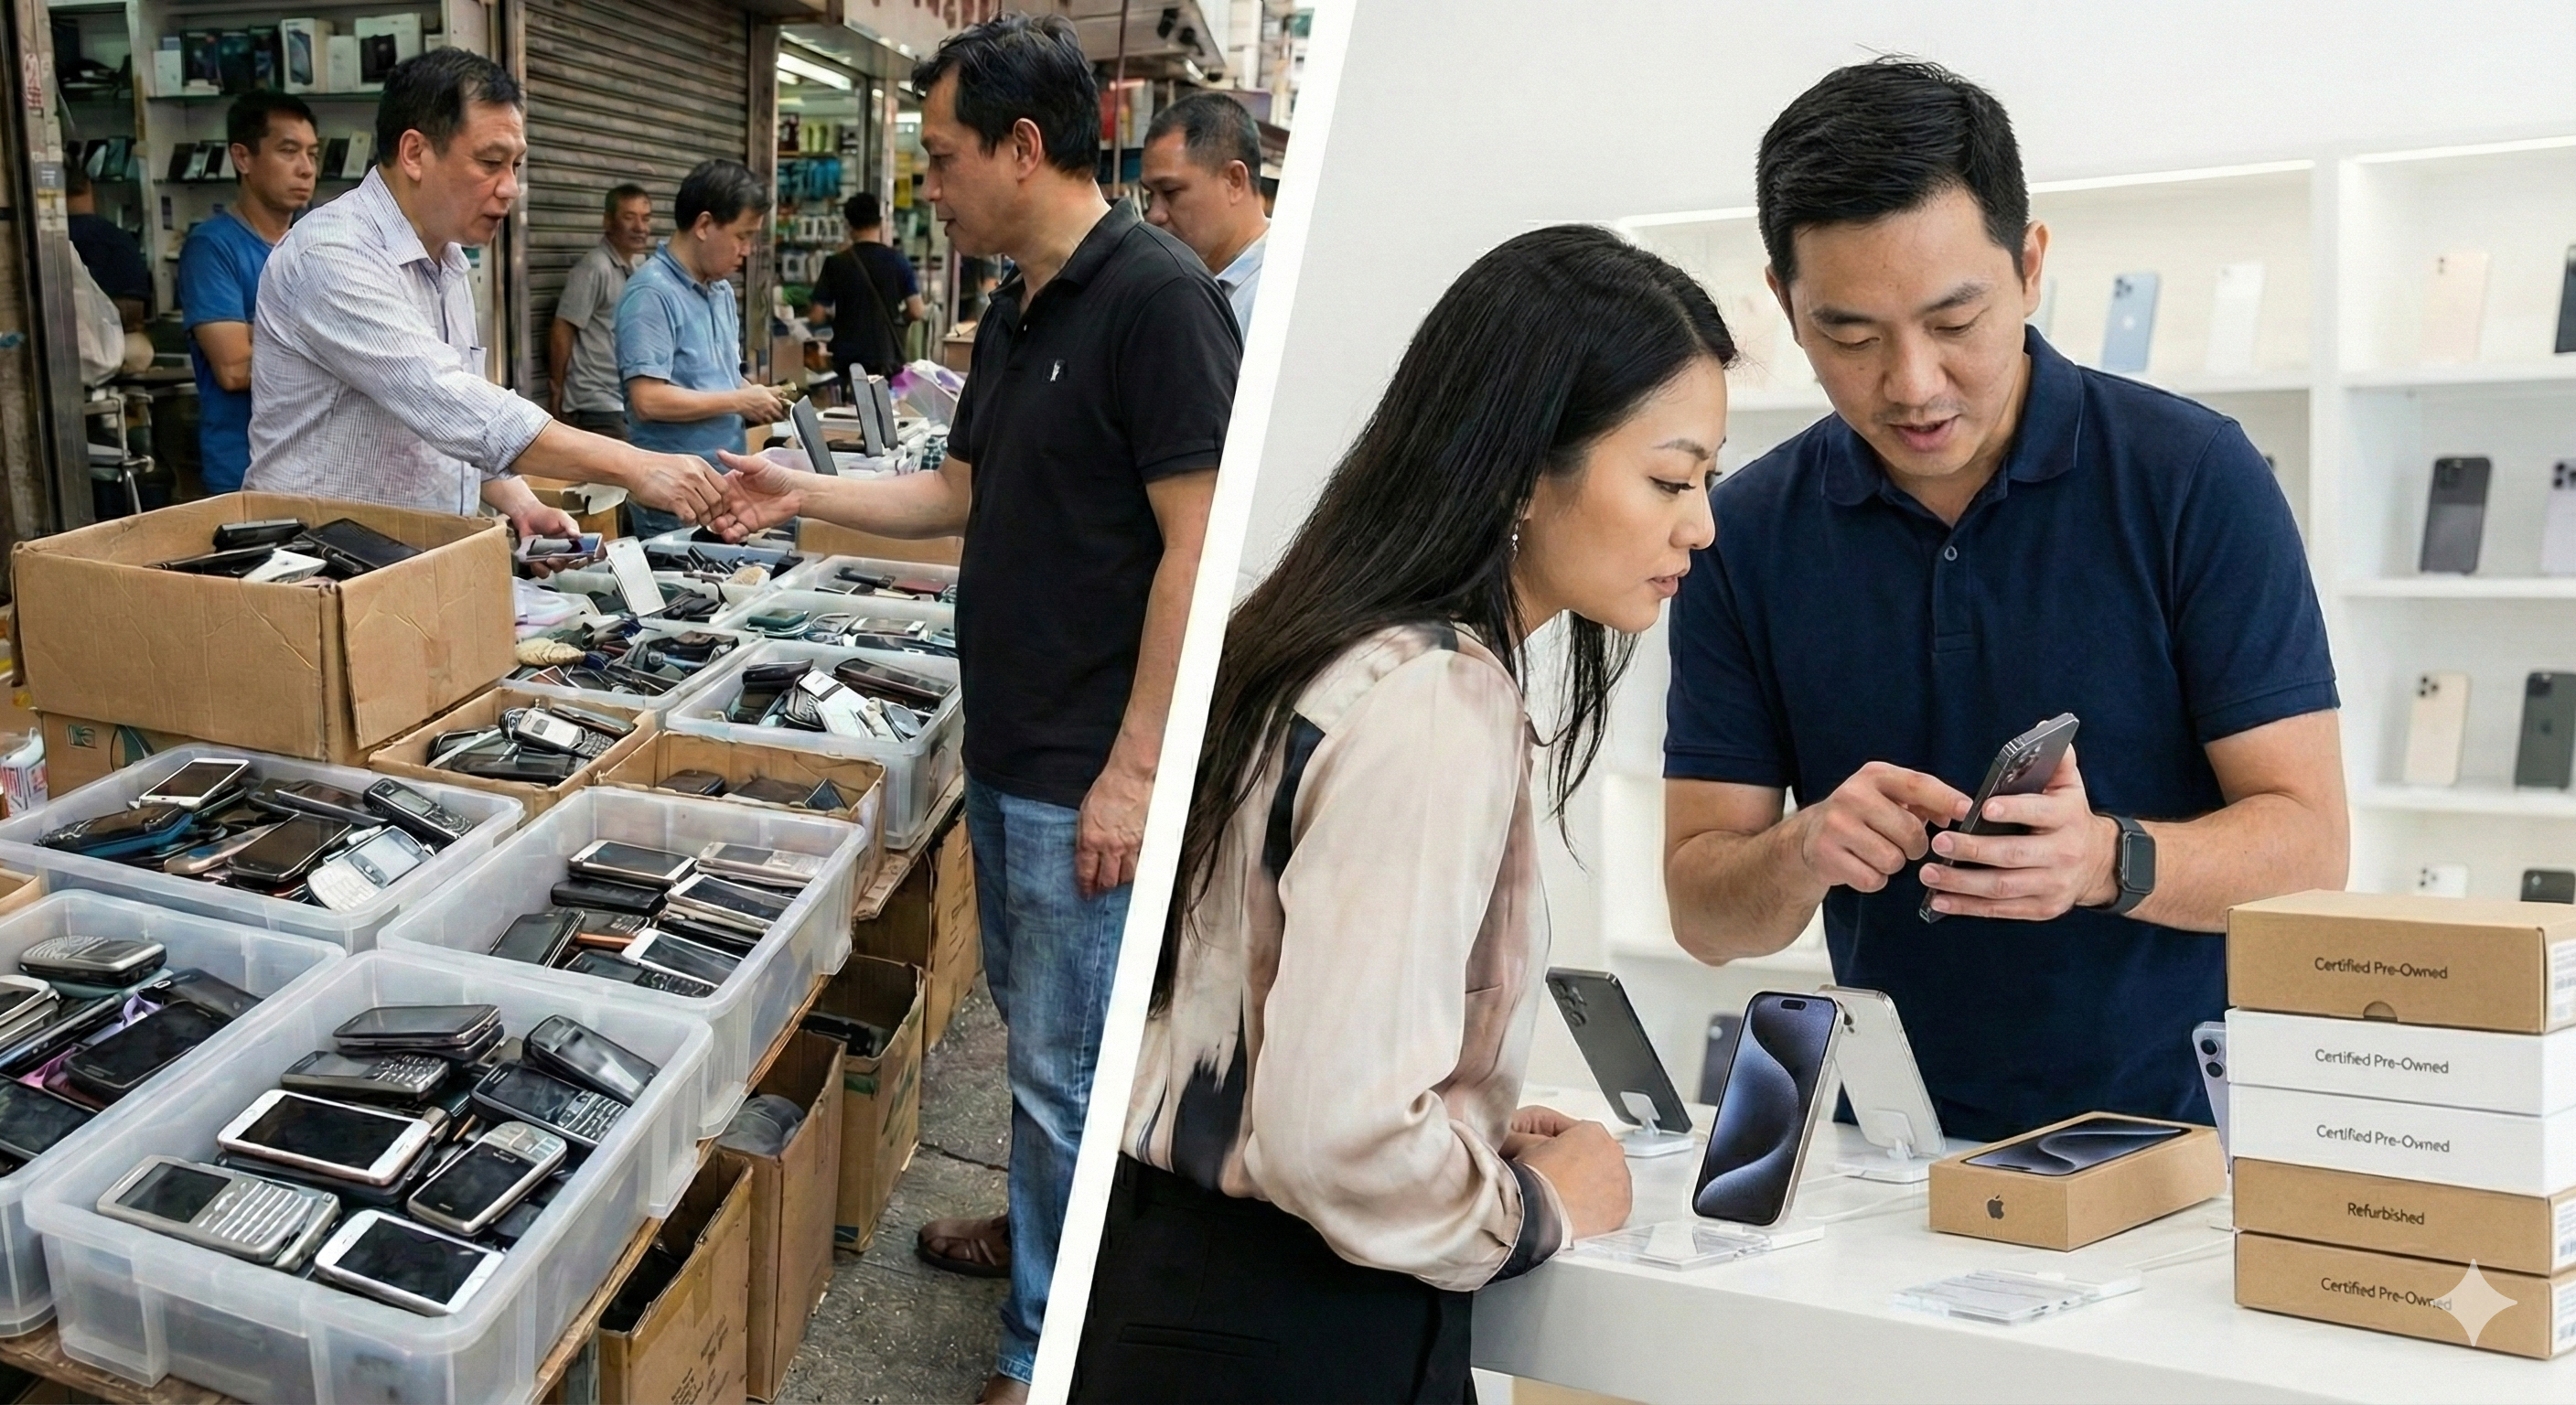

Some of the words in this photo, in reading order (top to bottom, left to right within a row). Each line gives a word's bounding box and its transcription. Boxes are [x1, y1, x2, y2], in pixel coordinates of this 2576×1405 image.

[2314, 957, 2371, 974] Certified
[2374, 961, 2448, 980] Pre-Owned
[2314, 1048, 2371, 1067] Certified
[2374, 1054, 2449, 1074] Pre-Owned
[2316, 1124, 2372, 1143] Certified
[2375, 1131, 2450, 1153] Pre-Owned
[2347, 1202, 2425, 1225] Refurbished
[2321, 1277, 2376, 1298] Certified
[2379, 1286, 2453, 1311] Pre-Owned
